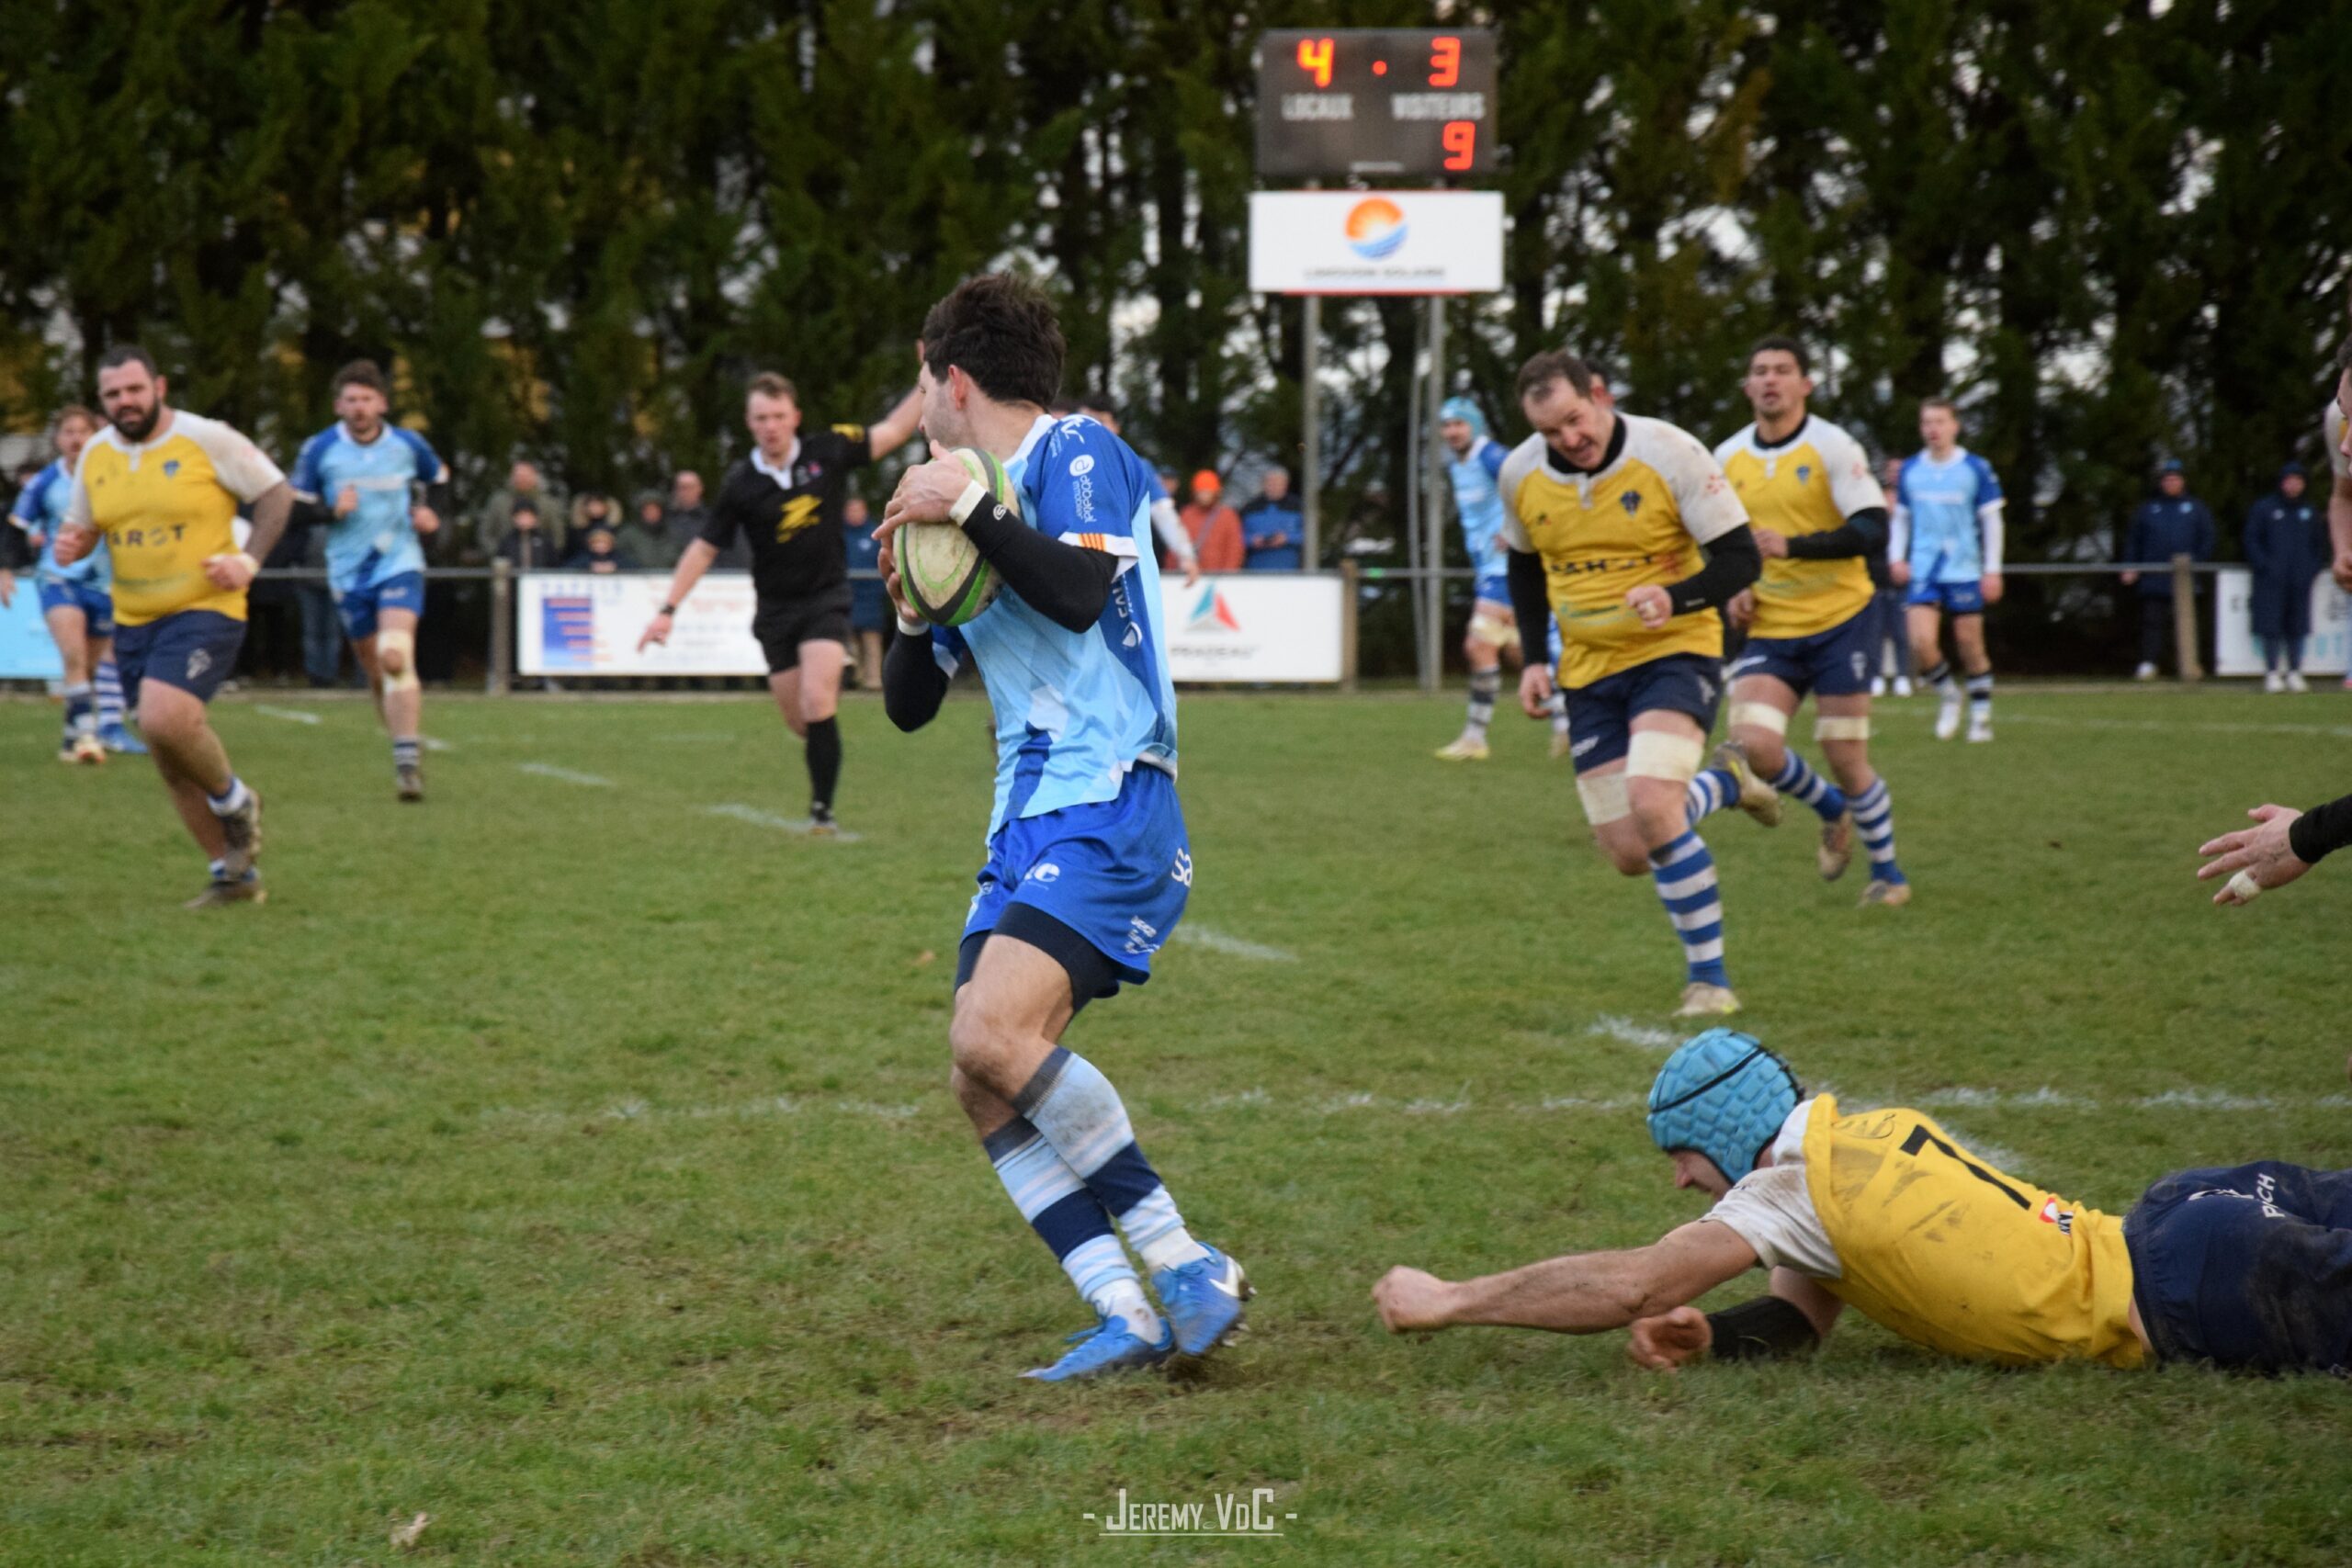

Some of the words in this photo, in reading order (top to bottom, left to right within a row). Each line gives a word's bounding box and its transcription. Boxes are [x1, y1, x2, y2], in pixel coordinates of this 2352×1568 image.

[1297, 38, 1334, 87] 4
[1429, 36, 1461, 87] 3
[1442, 121, 1476, 171] 9
[1899, 1123, 2031, 1212] 7
